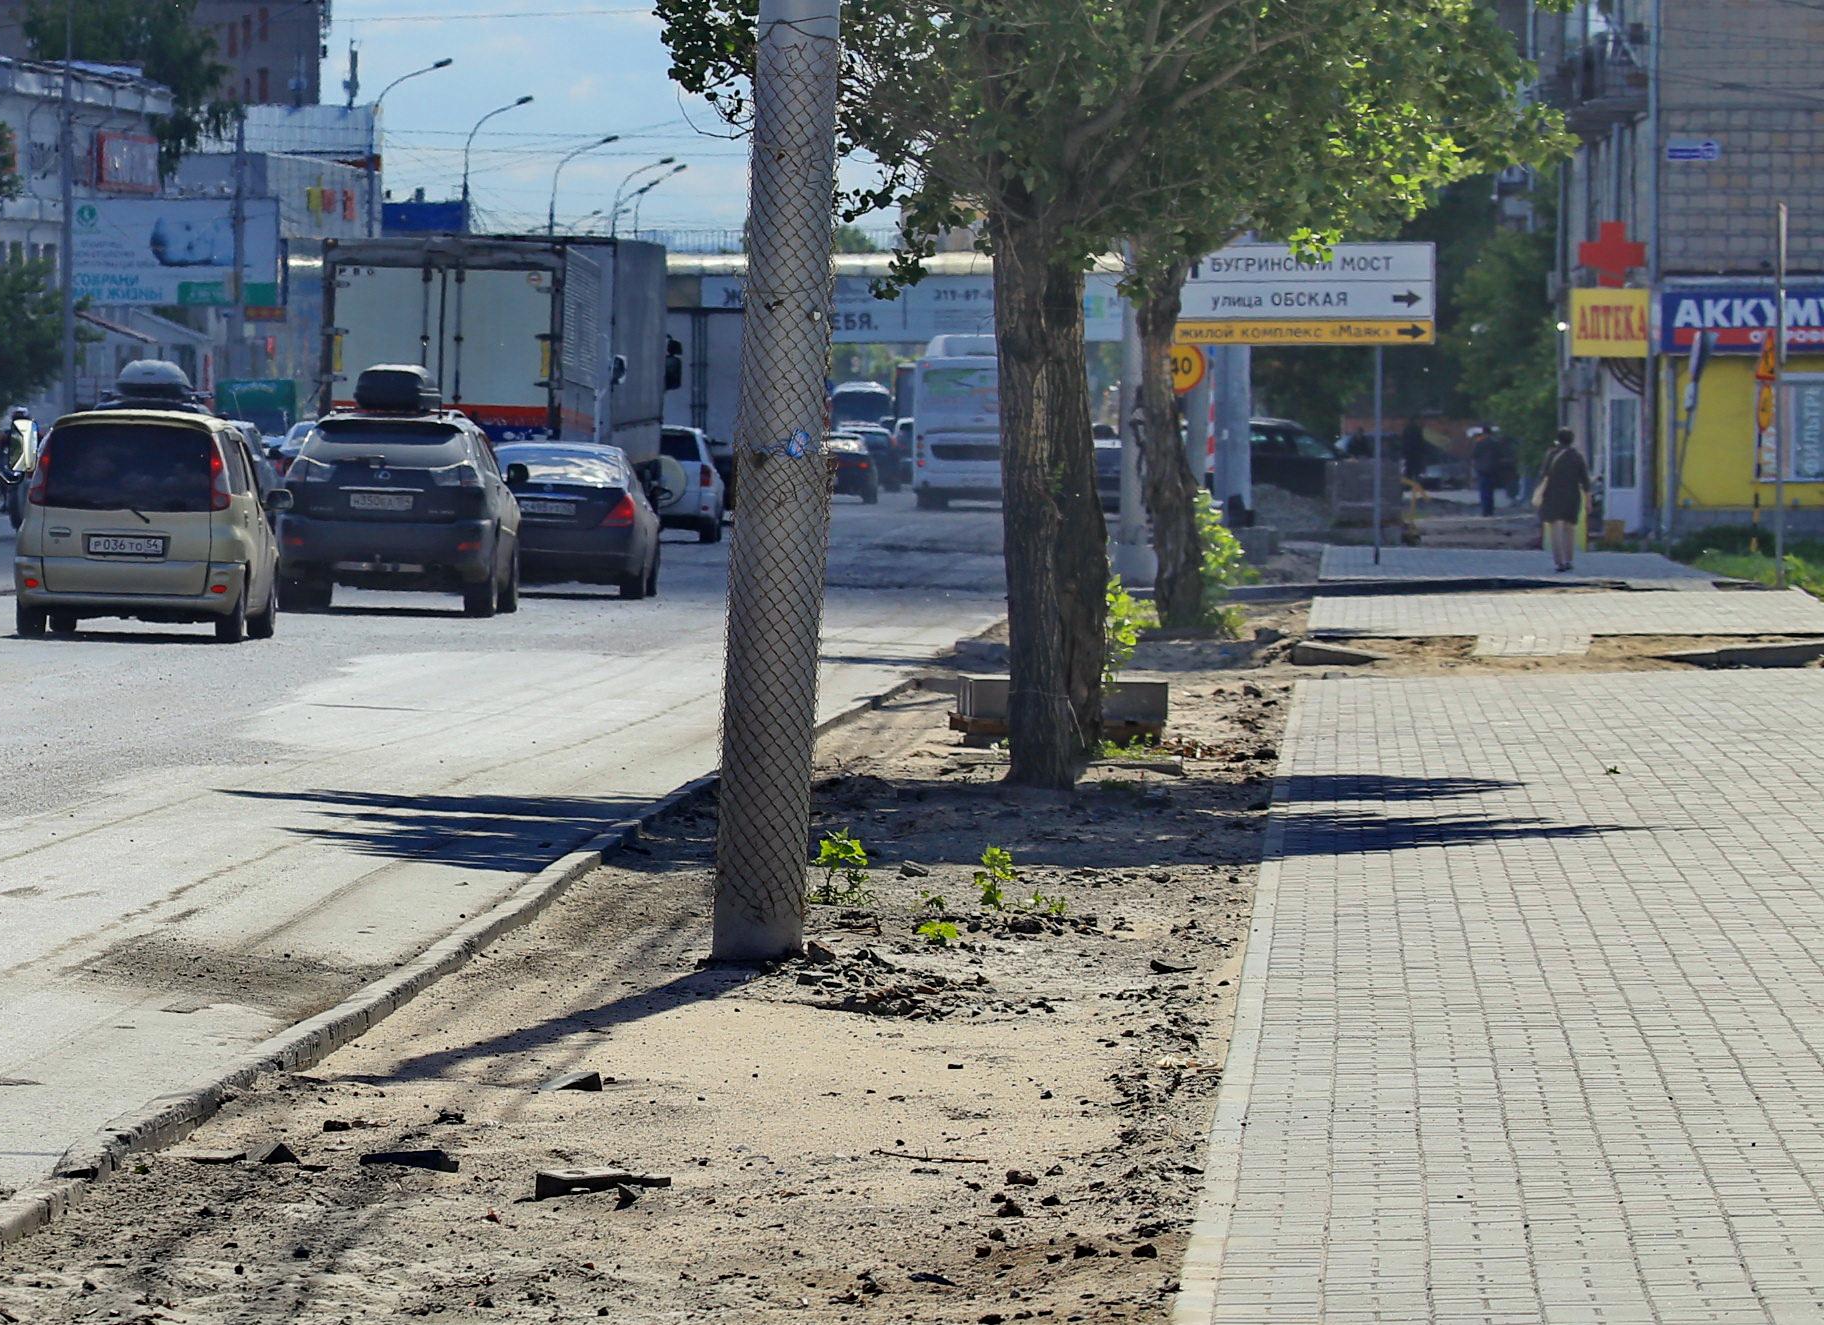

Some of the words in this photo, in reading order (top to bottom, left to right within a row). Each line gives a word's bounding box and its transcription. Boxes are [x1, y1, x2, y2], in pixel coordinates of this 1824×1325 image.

[1340, 256, 1394, 272] МОСТ
[1210, 294, 1264, 310] улица
[1271, 292, 1349, 307] ОБСКАЯ
[831, 312, 879, 331] ЕБЯ.
[1576, 304, 1647, 340] АПТЕКА
[1673, 298, 1824, 328] АККУМ
[1179, 324, 1234, 339] жилой
[1241, 326, 1323, 339] комплекс
